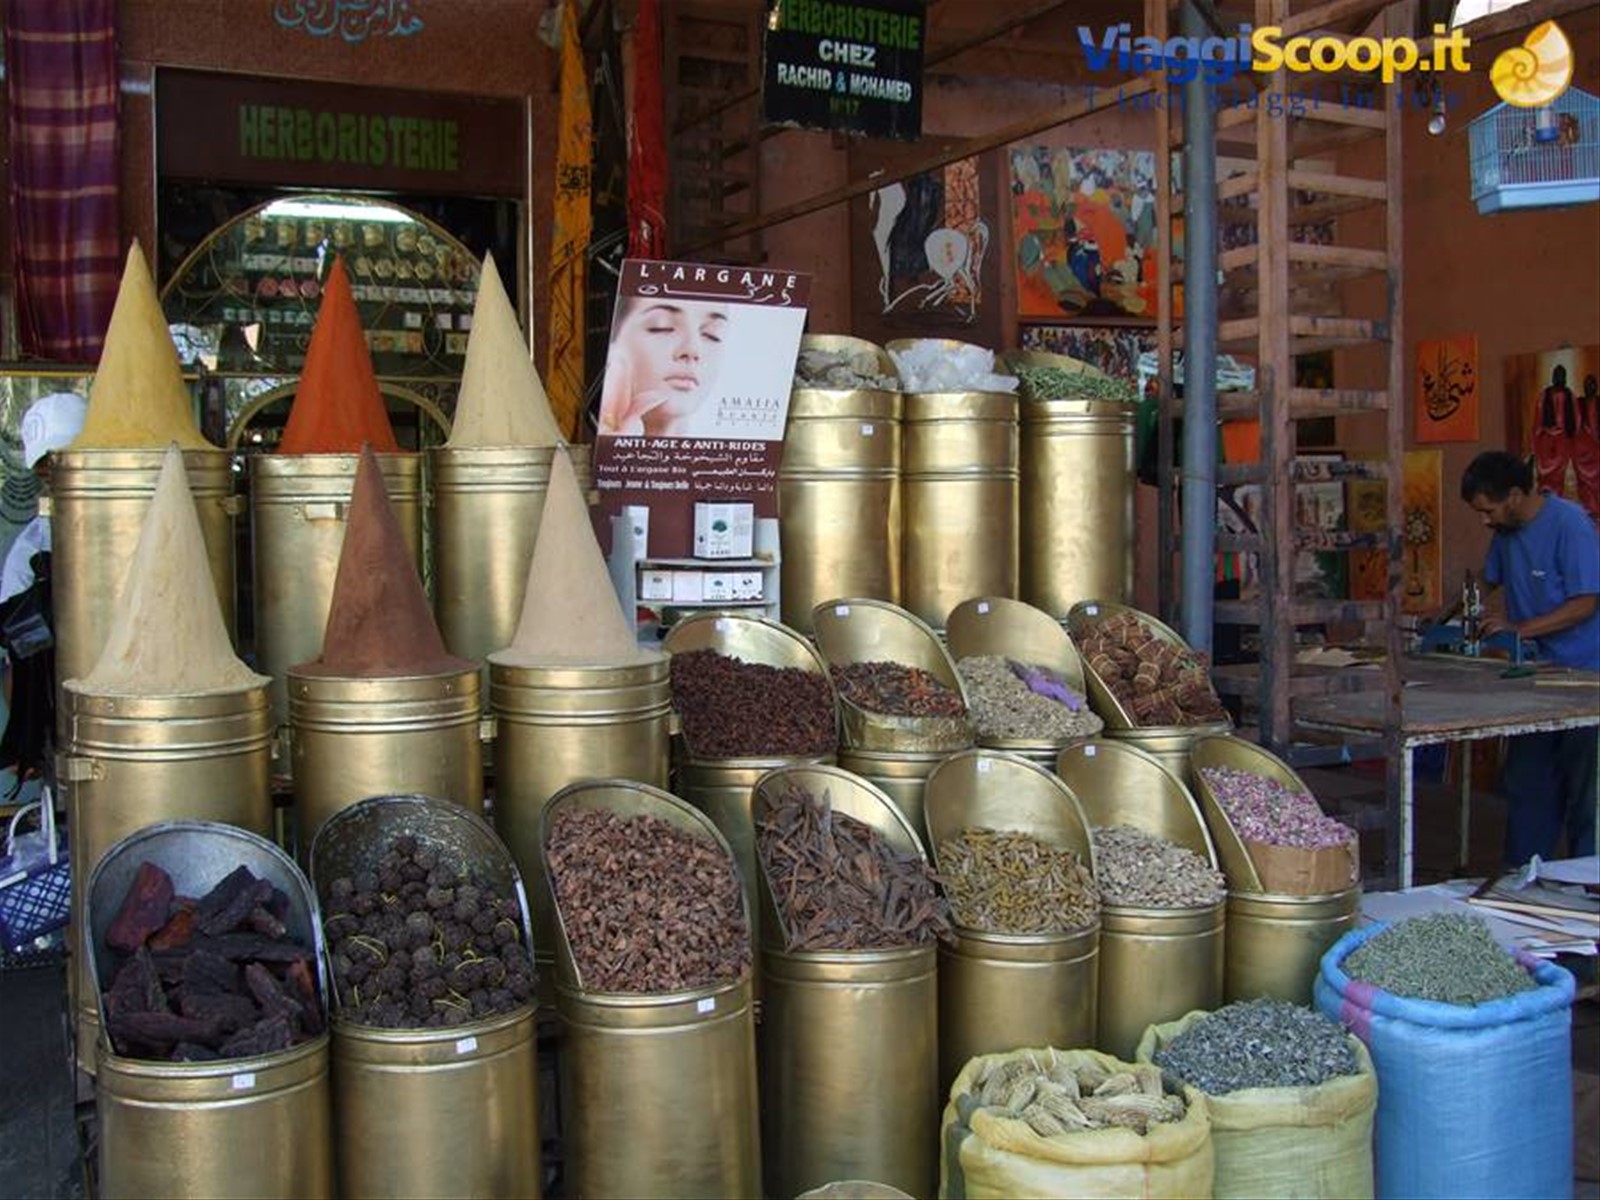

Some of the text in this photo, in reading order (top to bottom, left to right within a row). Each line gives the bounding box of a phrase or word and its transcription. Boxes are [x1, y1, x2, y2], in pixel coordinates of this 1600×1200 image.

[818, 39, 876, 67] CHEZ
[777, 63, 912, 102] RACHID & MOHAMED
[239, 104, 458, 171] HERBORISTERIE
[640, 264, 796, 288] L'ARGANE
[614, 438, 767, 451] ANTI-AGE & ANTI-RIDES
